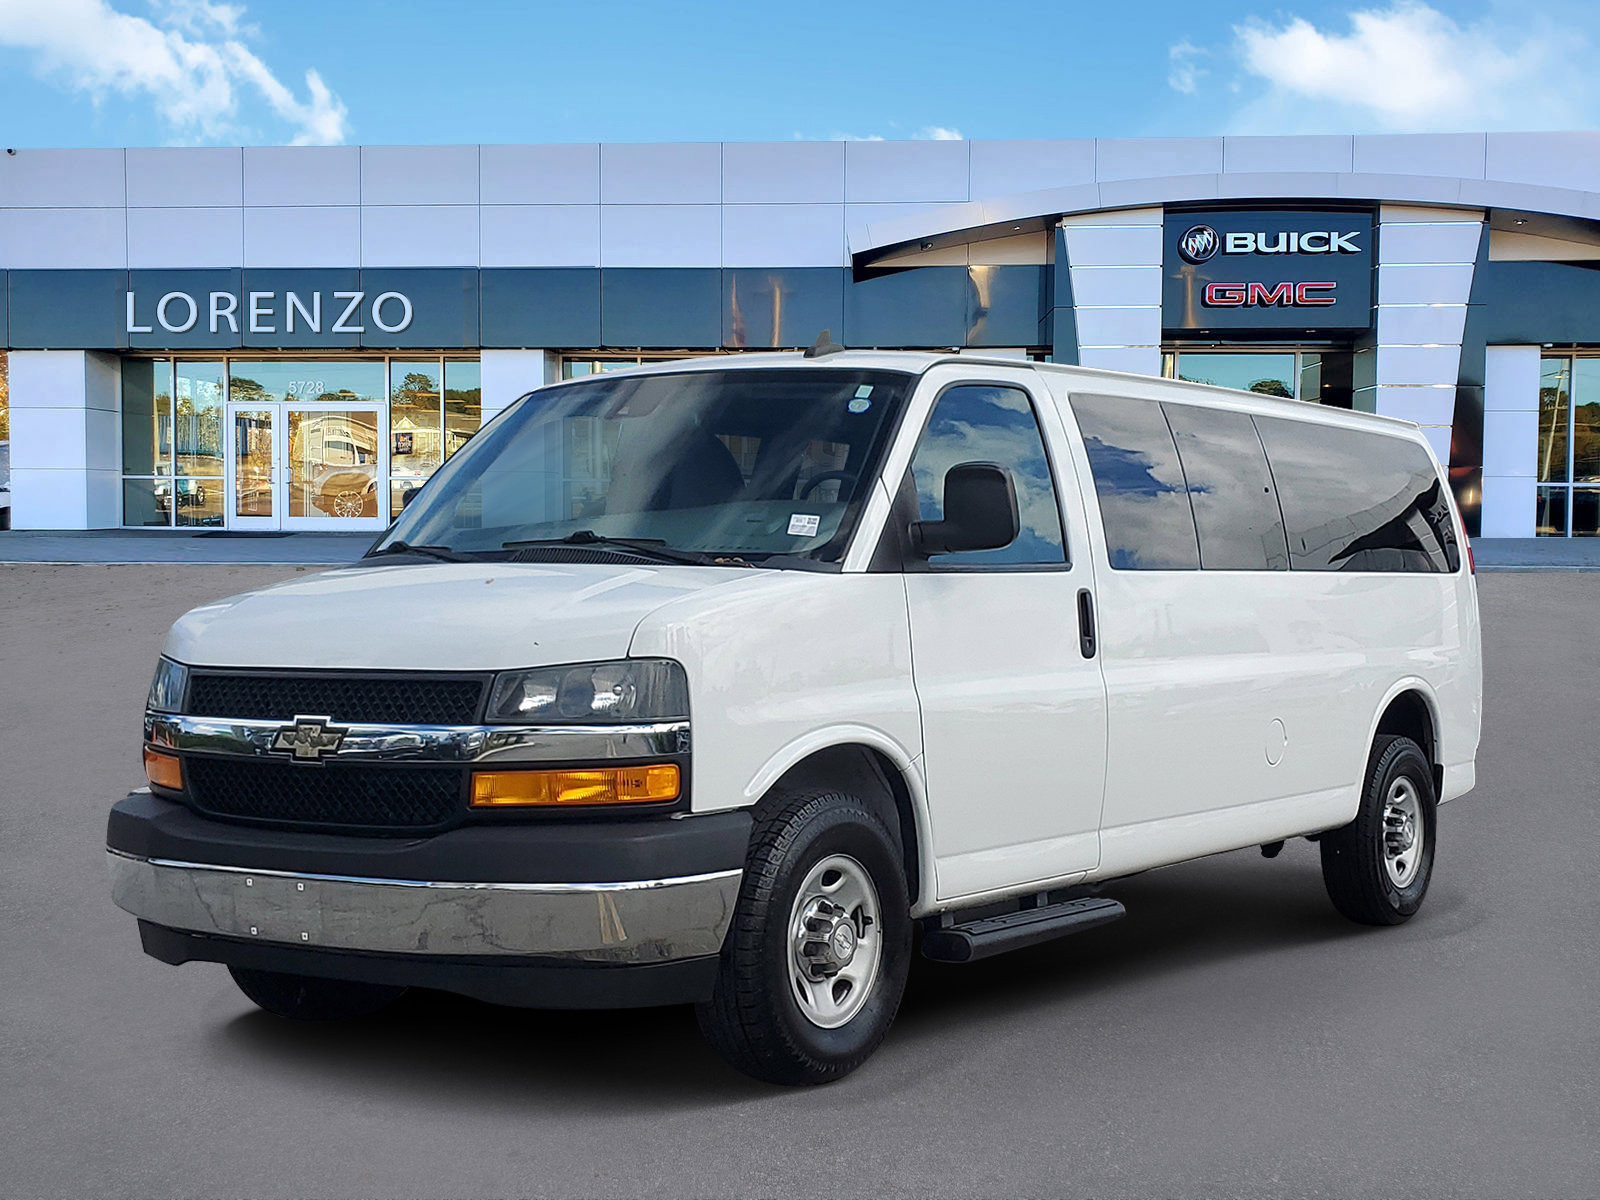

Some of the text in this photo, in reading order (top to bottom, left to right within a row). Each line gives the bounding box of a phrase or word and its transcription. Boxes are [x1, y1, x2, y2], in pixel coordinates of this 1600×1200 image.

[1225, 231, 1362, 253] BUICK
[1205, 281, 1337, 306] GMC
[126, 291, 415, 334] LORENZO
[287, 380, 325, 395] 5728
